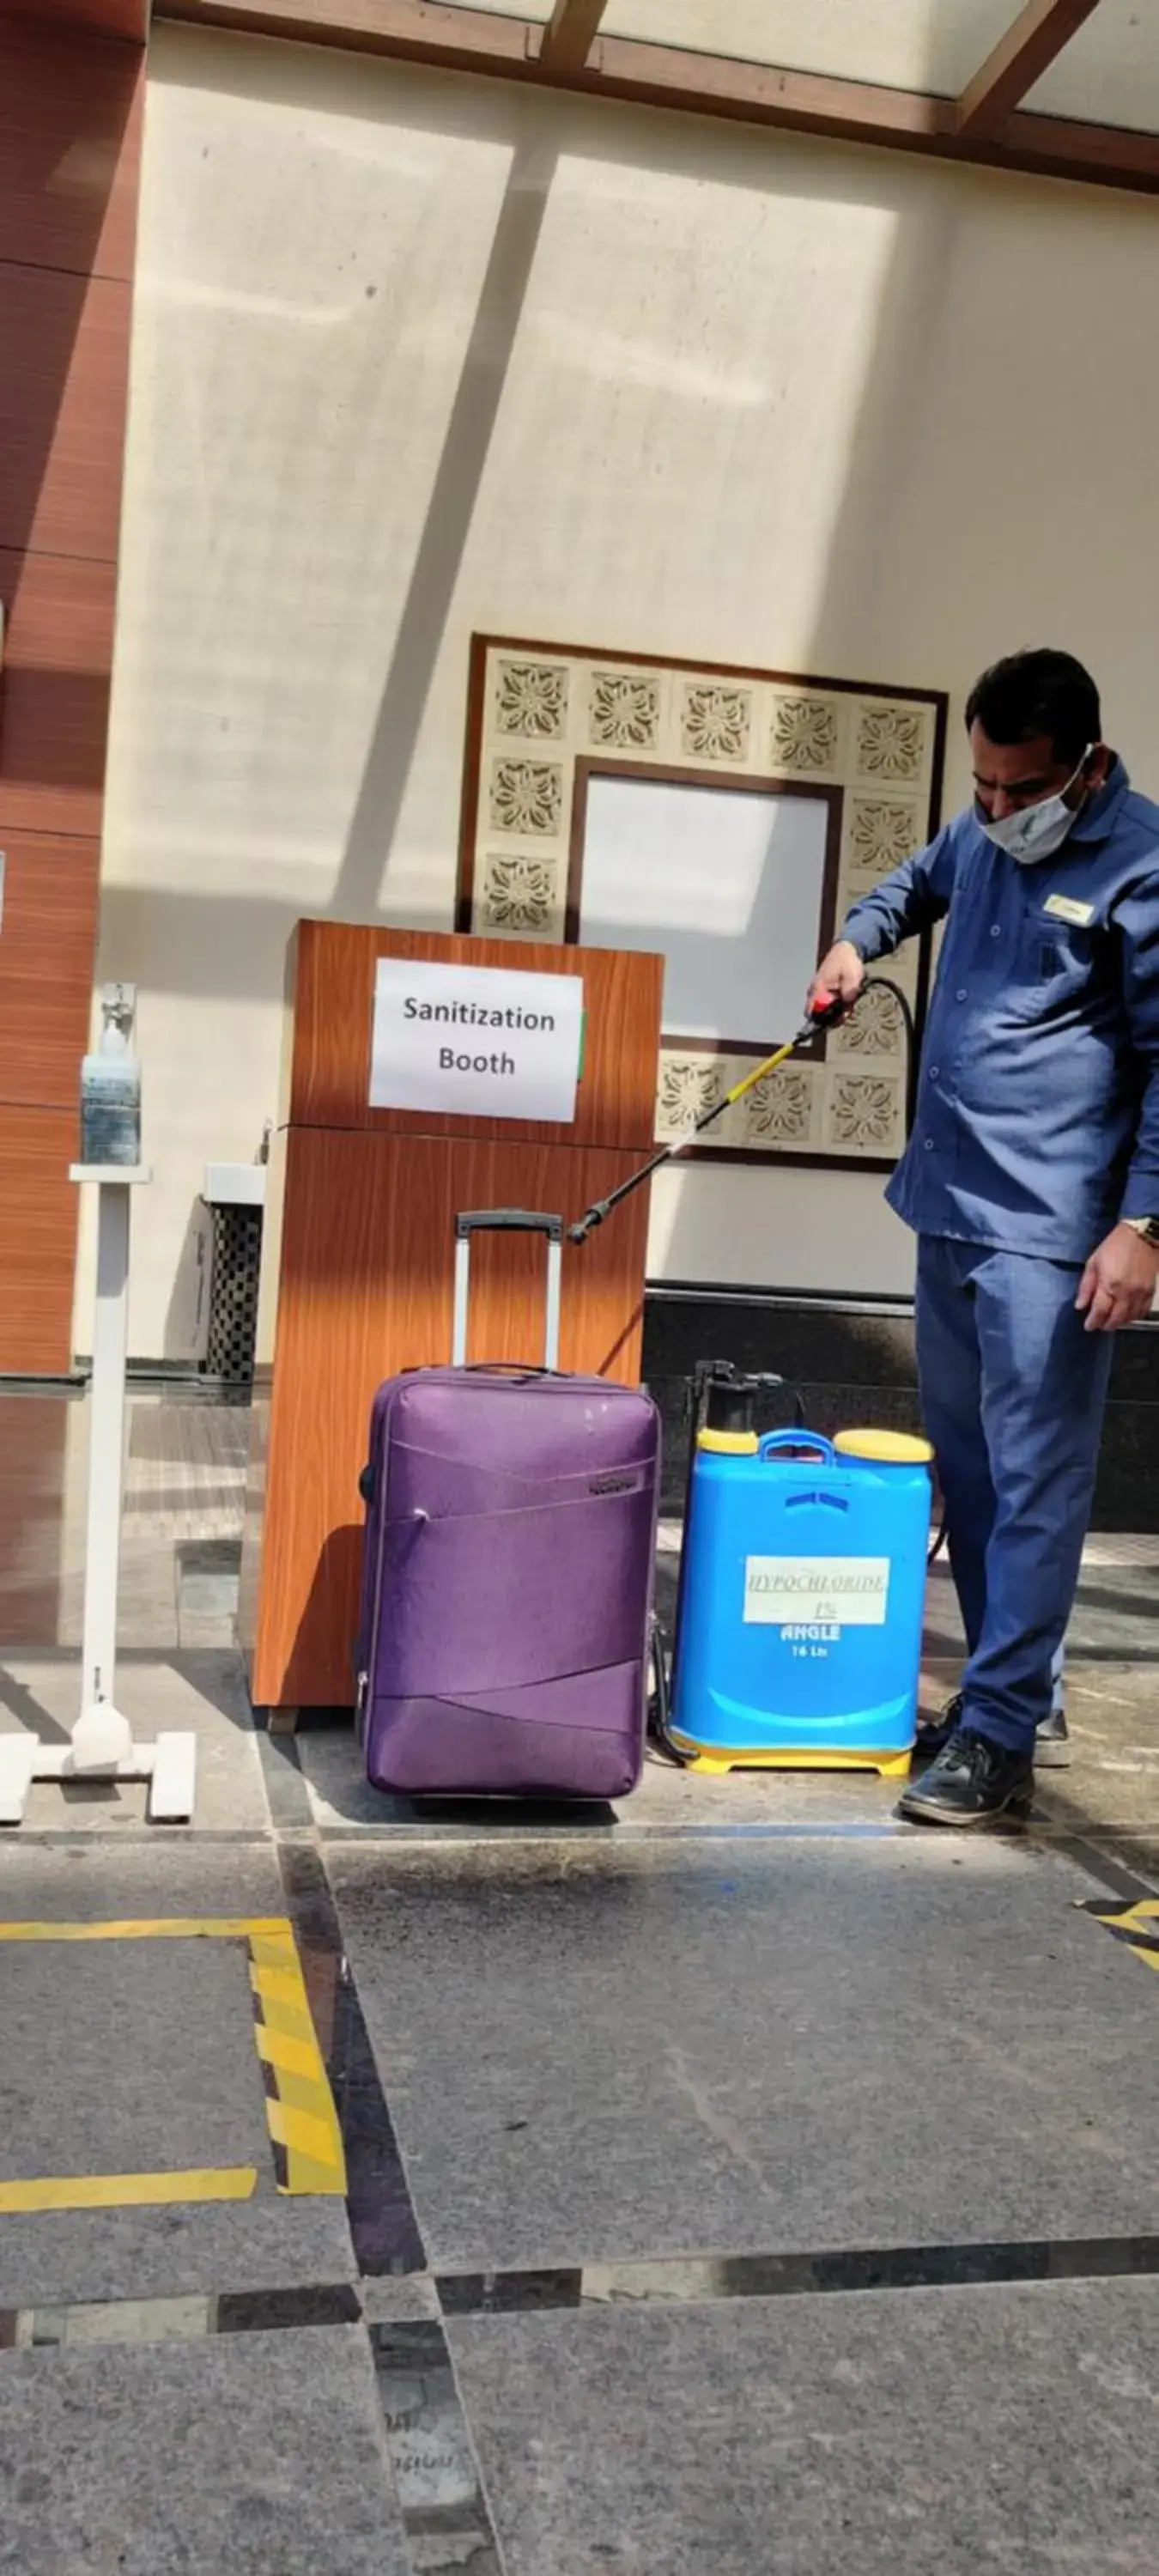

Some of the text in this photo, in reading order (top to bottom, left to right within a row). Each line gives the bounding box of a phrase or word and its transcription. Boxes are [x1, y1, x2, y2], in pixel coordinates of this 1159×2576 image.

[404, 997, 555, 1031] Sanitization
[439, 1047, 515, 1074] Booth
[749, 1573, 884, 1592] HYPOCHLORIDE
